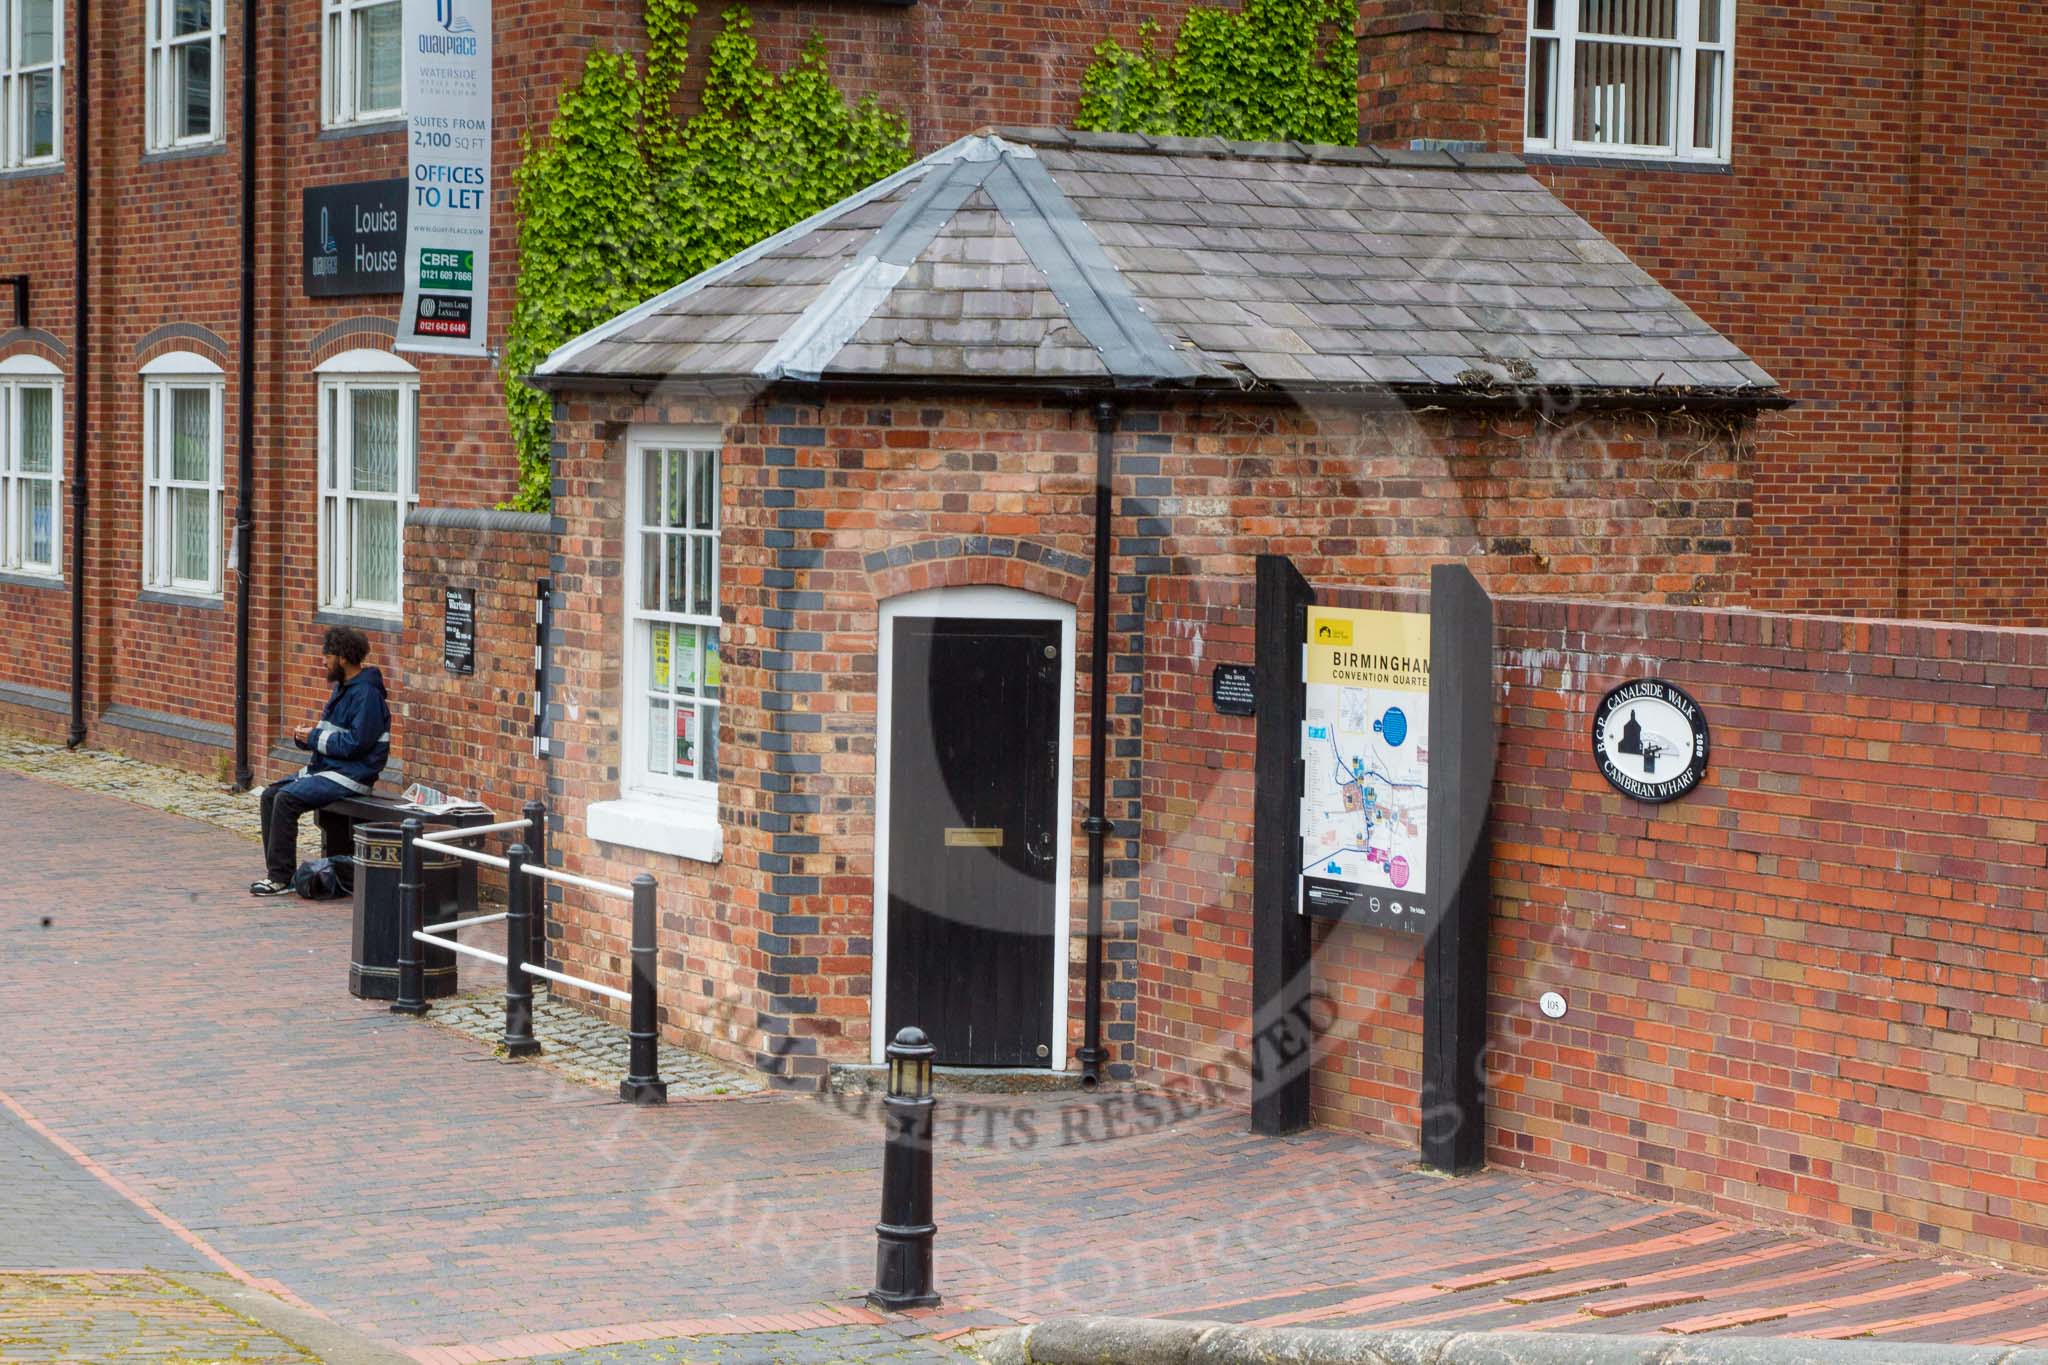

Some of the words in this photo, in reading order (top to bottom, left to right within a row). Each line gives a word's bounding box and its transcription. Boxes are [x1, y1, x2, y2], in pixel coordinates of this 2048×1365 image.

[419, 66, 477, 80] WATERSIDE
[413, 116, 448, 128] SUITES
[453, 118, 486, 130] FROM
[414, 131, 451, 148] 2,100
[454, 137, 469, 150] SQ
[472, 138, 485, 150] FT
[415, 164, 484, 184] OFFICES
[415, 186, 441, 207] TO
[448, 188, 484, 209] LET
[355, 203, 397, 233] Louisa
[355, 243, 397, 273] House
[421, 252, 459, 267] CBRE
[421, 269, 438, 279] 0121
[440, 270, 453, 280] 609
[420, 321, 434, 330] 0121
[1332, 669, 1389, 683] CONVENTION
[1392, 675, 1428, 687] QUARTE
[1607, 683, 1664, 711] CANALSIDE
[1667, 688, 1696, 720] WALK
[1603, 760, 1656, 797] CAMBRIAN
[1658, 767, 1694, 797] WHARF
